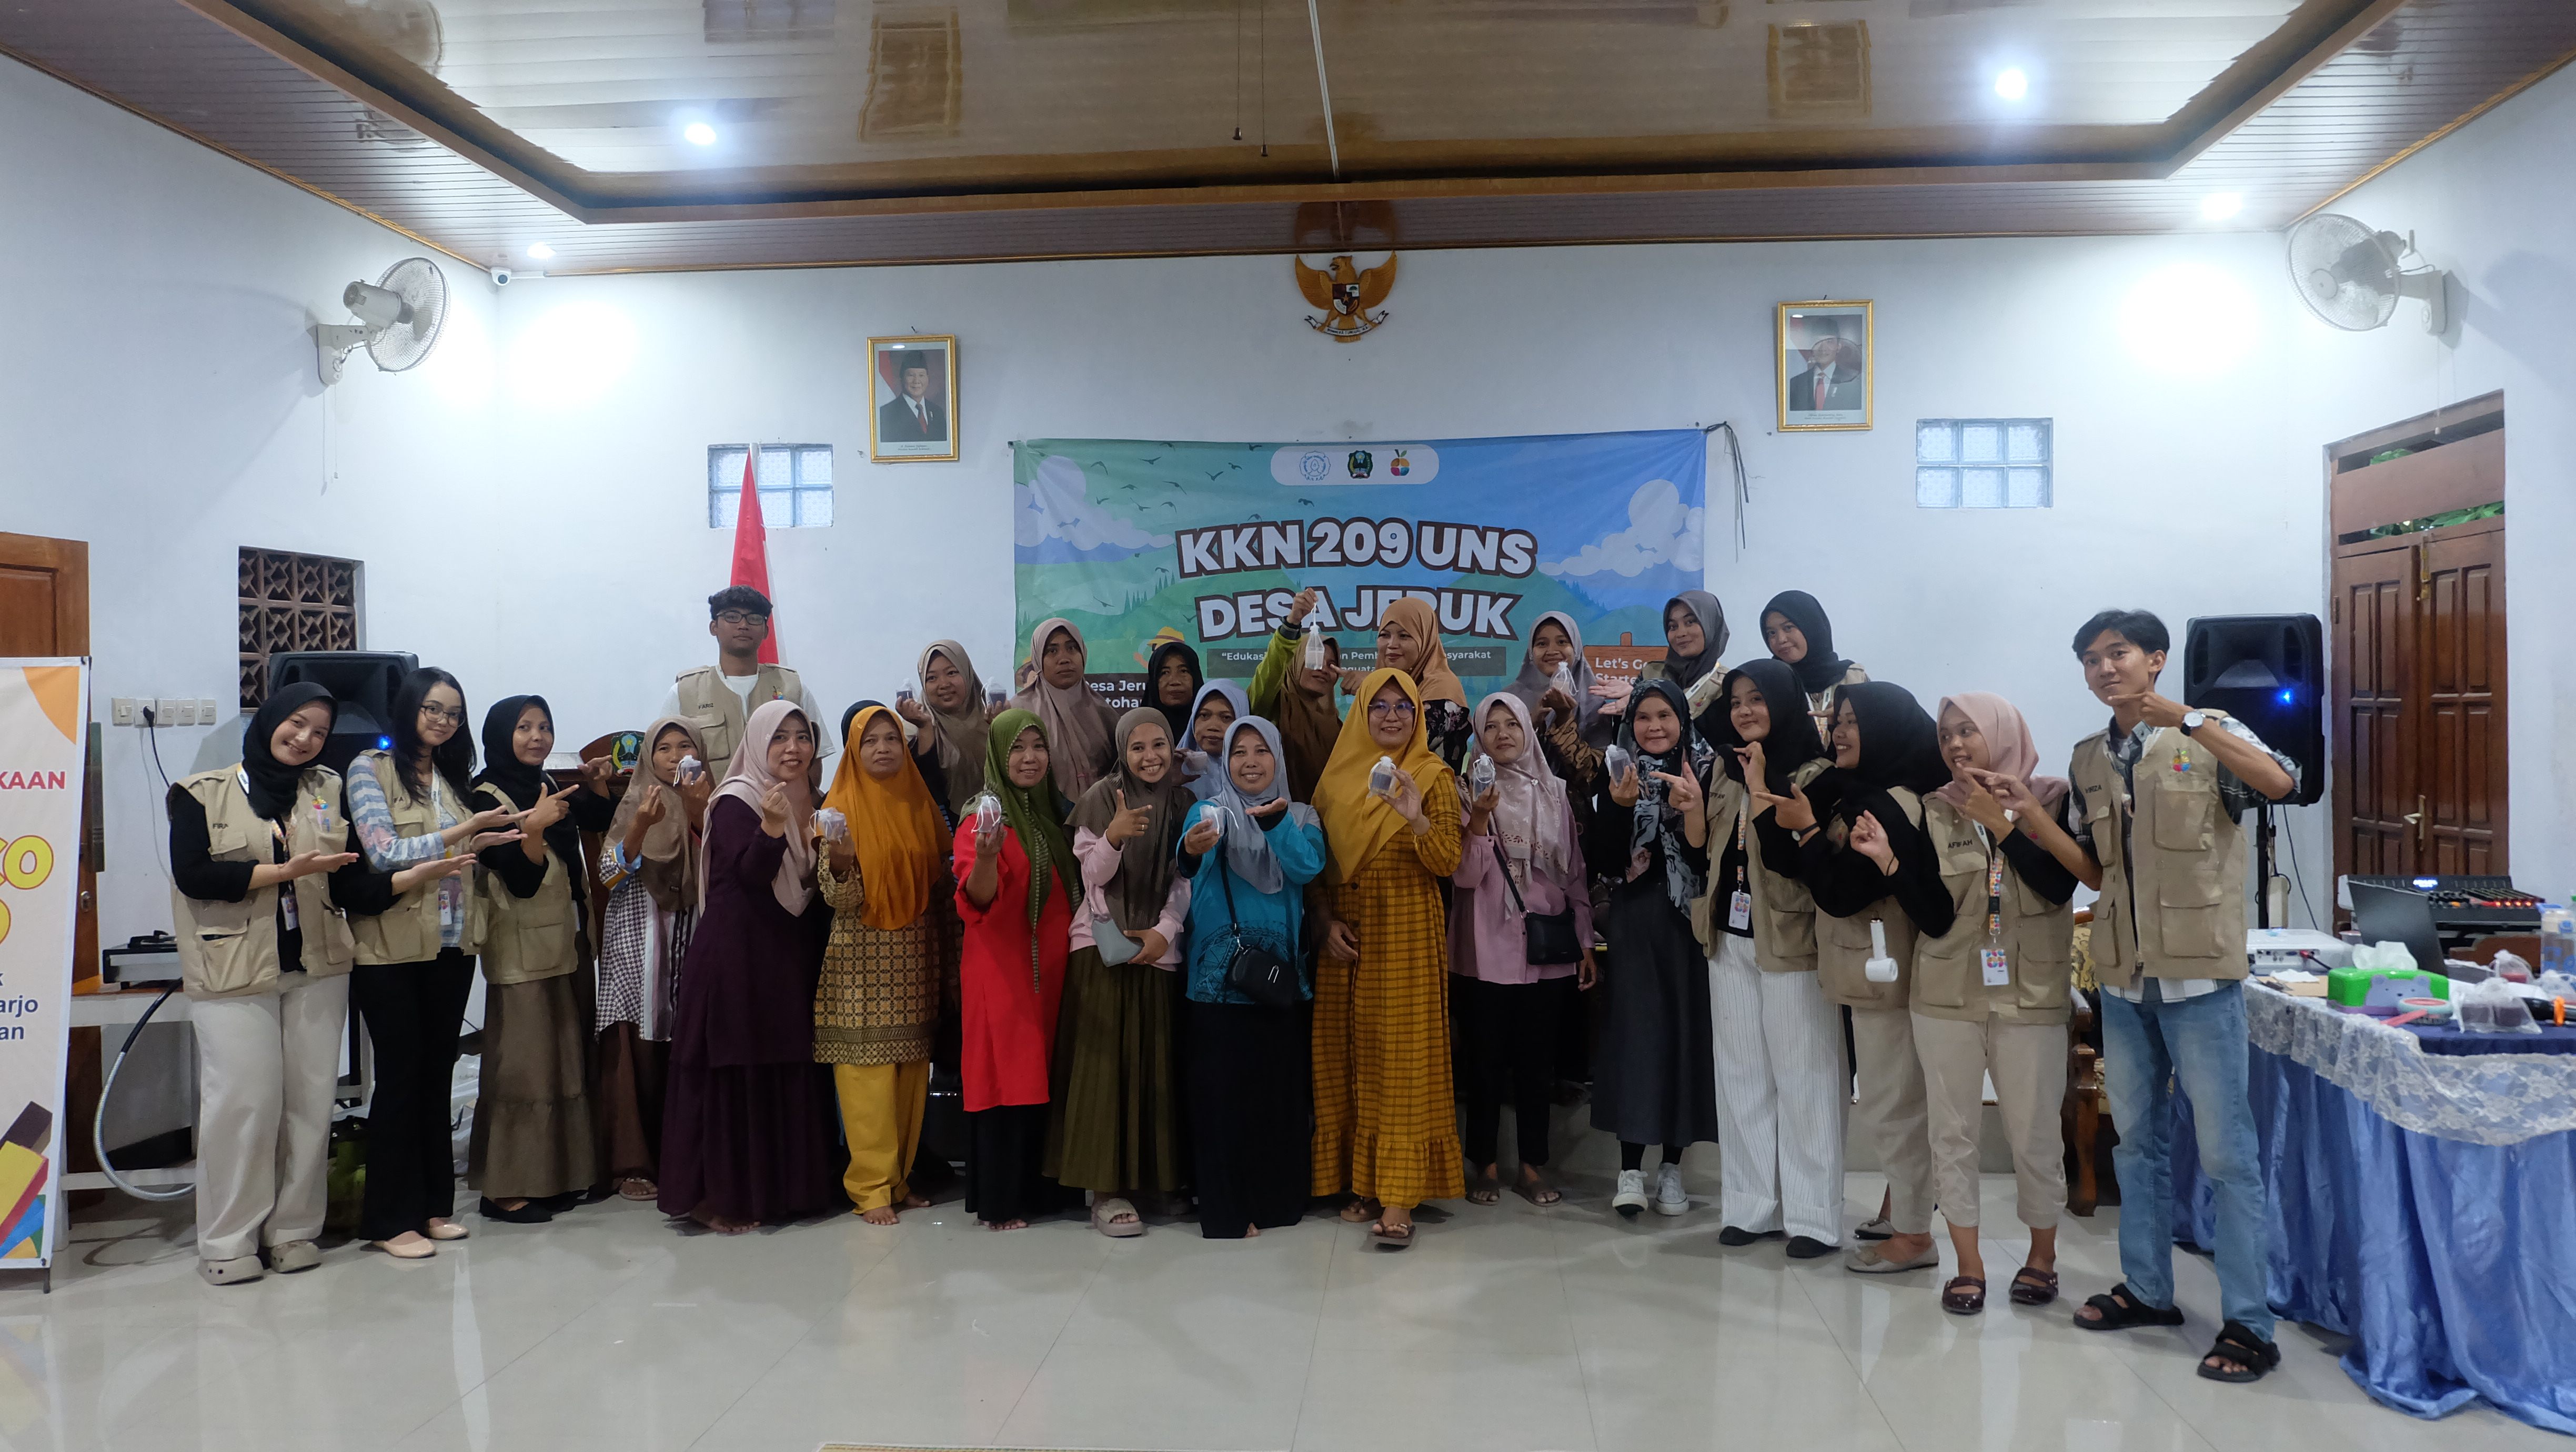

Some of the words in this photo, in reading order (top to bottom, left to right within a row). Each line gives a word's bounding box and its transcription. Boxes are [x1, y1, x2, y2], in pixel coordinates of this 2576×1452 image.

[1179, 523, 1303, 576] KKN
[1310, 520, 1411, 566] 209
[1418, 523, 1535, 576] UNS
[1595, 657, 1628, 669] Let's
[1085, 680, 1114, 691] esa
